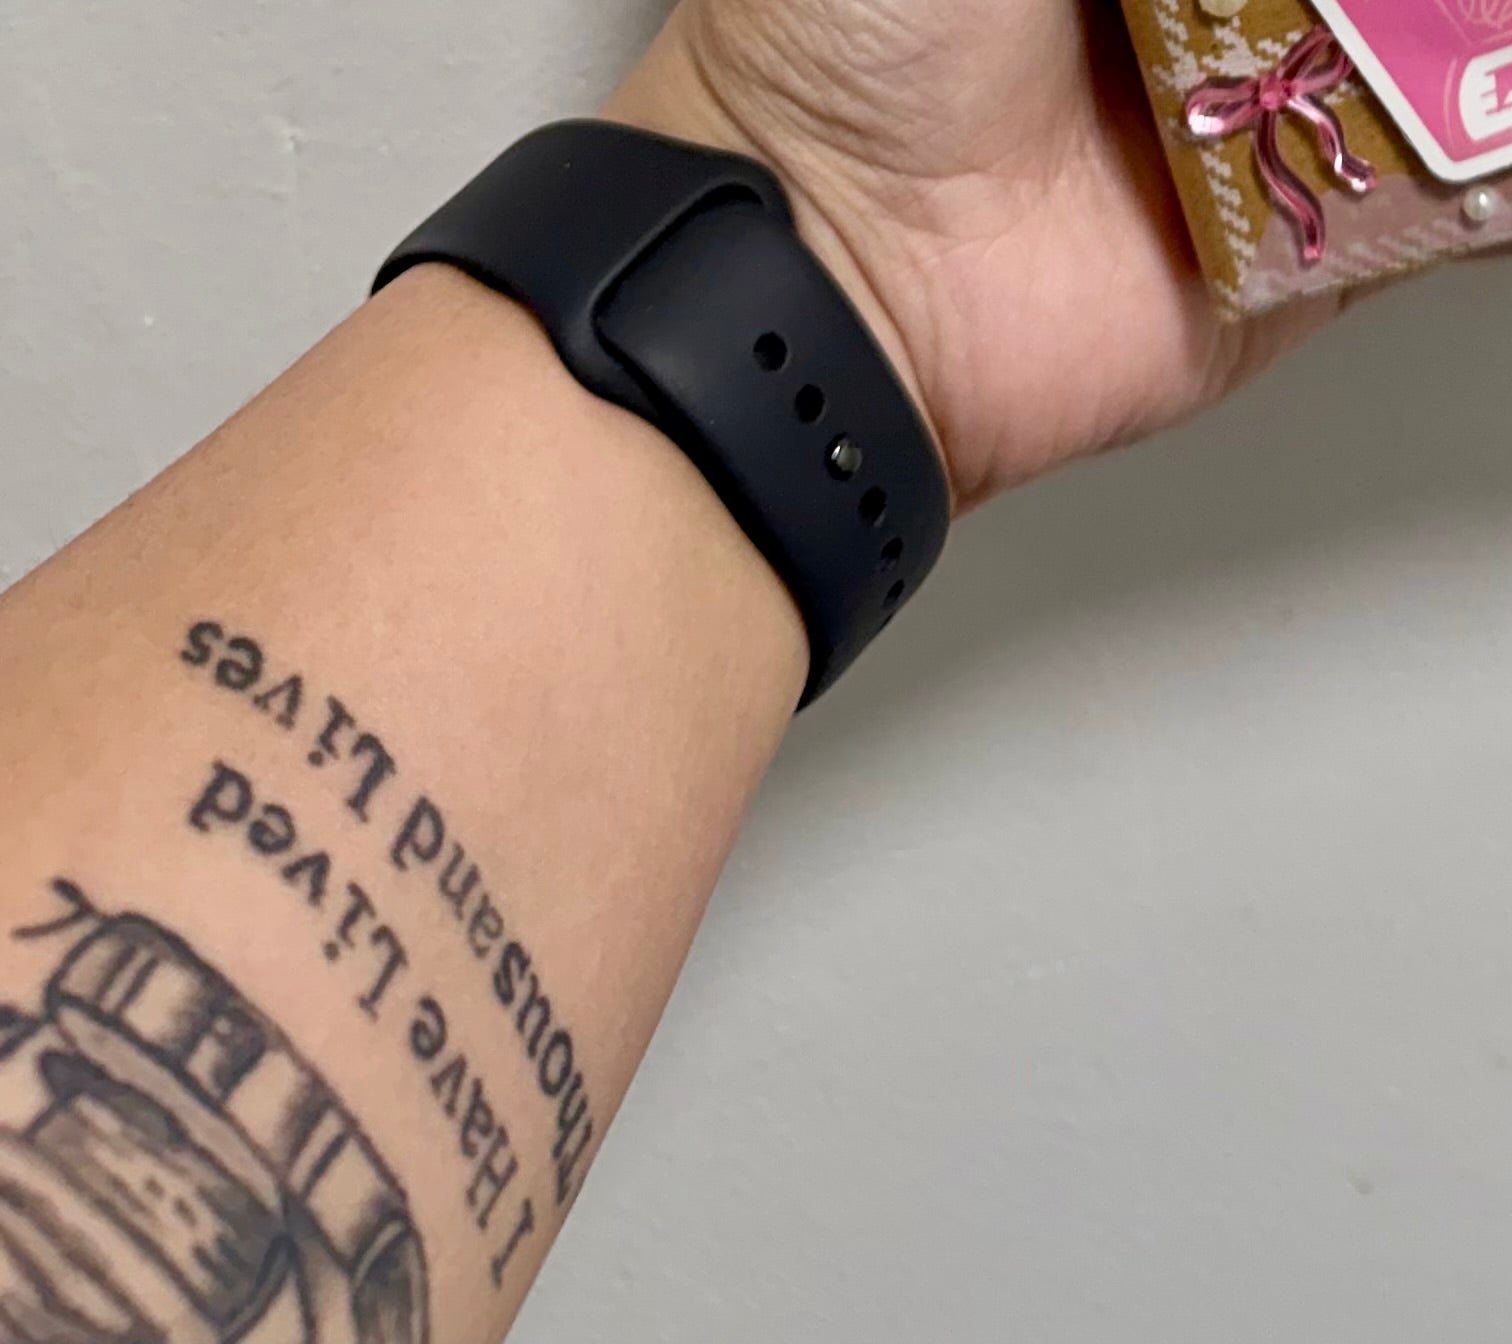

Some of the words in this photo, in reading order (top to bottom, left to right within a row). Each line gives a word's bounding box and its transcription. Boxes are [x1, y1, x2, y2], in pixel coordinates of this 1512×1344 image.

[178, 618, 398, 824] Lives
[187, 758, 410, 1024] Lived
[409, 996, 520, 1231] Have
[489, 1196, 536, 1292] I
